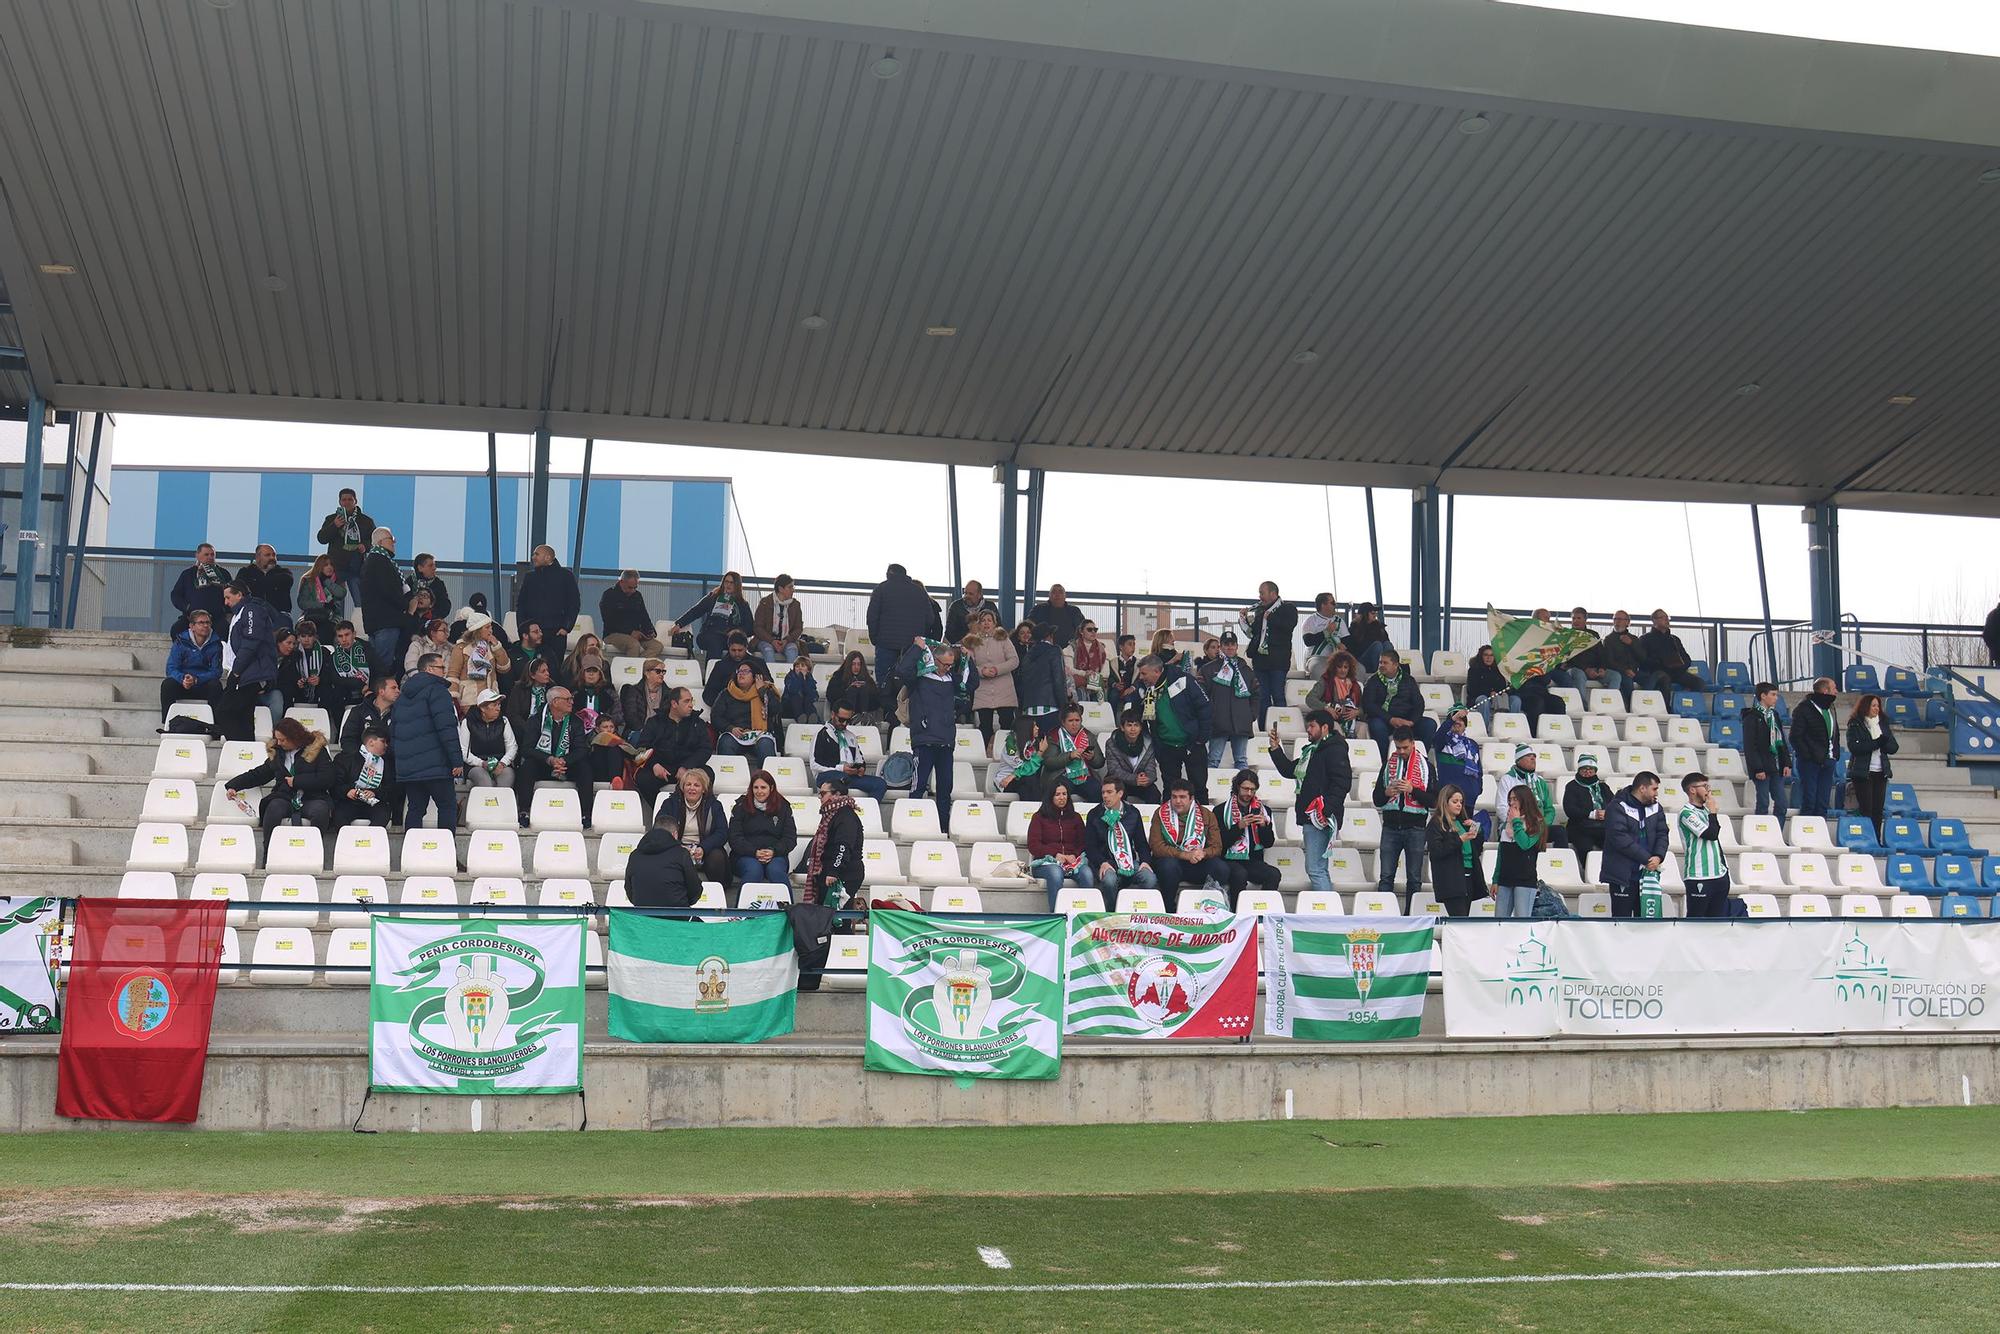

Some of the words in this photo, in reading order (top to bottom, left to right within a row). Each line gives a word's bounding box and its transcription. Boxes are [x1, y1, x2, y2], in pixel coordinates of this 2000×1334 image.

[1150, 916, 1204, 927] CORDOBESISTA
[942, 936, 1018, 957] CORDOBESISTA
[1091, 927, 1162, 947] A4CIENTOS
[1166, 932, 1184, 947] DE
[1189, 929, 1237, 947] MADRID
[452, 939, 537, 963] CORDOBESISTA
[1564, 982, 1644, 996] DIPUTACIÓN
[1648, 985, 1663, 996] DE
[1892, 981, 1967, 995] DIPUTACIÓN
[1971, 984, 1986, 994] DE
[1348, 1010, 1379, 1022] 1954
[1563, 998, 1663, 1019] TOLEDO
[1892, 997, 1985, 1017] TOLEDO
[913, 1028, 926, 1041] LOS
[927, 1036, 964, 1051] PORRONES
[965, 1032, 1019, 1051] BLANQUIVERDES
[421, 1043, 436, 1056] LOS
[437, 1050, 478, 1067] PORRONES
[478, 1043, 538, 1067] BLANQUIVERDES
[443, 1064, 475, 1077] RAMBLA
